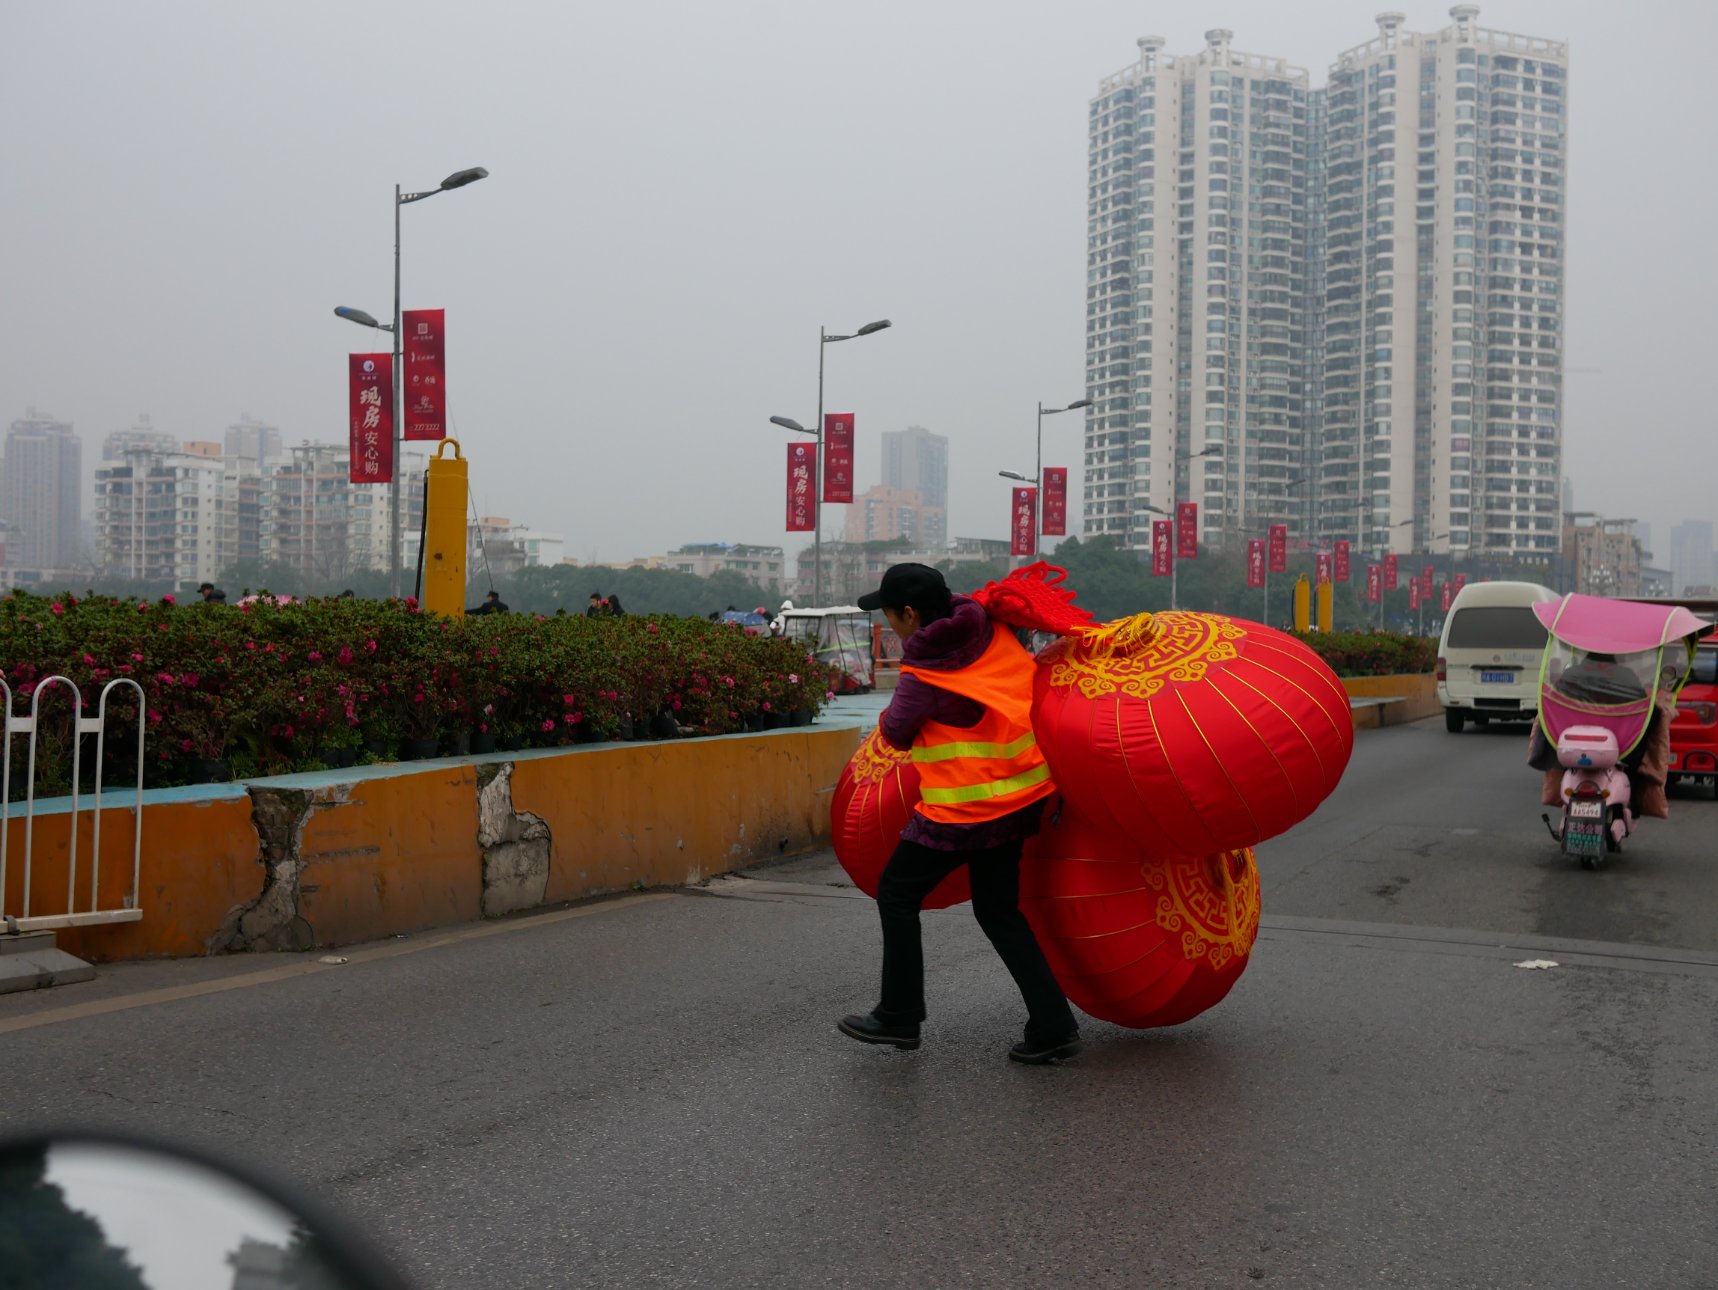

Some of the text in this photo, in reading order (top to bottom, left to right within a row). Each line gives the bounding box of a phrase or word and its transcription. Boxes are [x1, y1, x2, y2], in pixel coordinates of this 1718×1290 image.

[359, 386, 382, 475] 现房安心购
